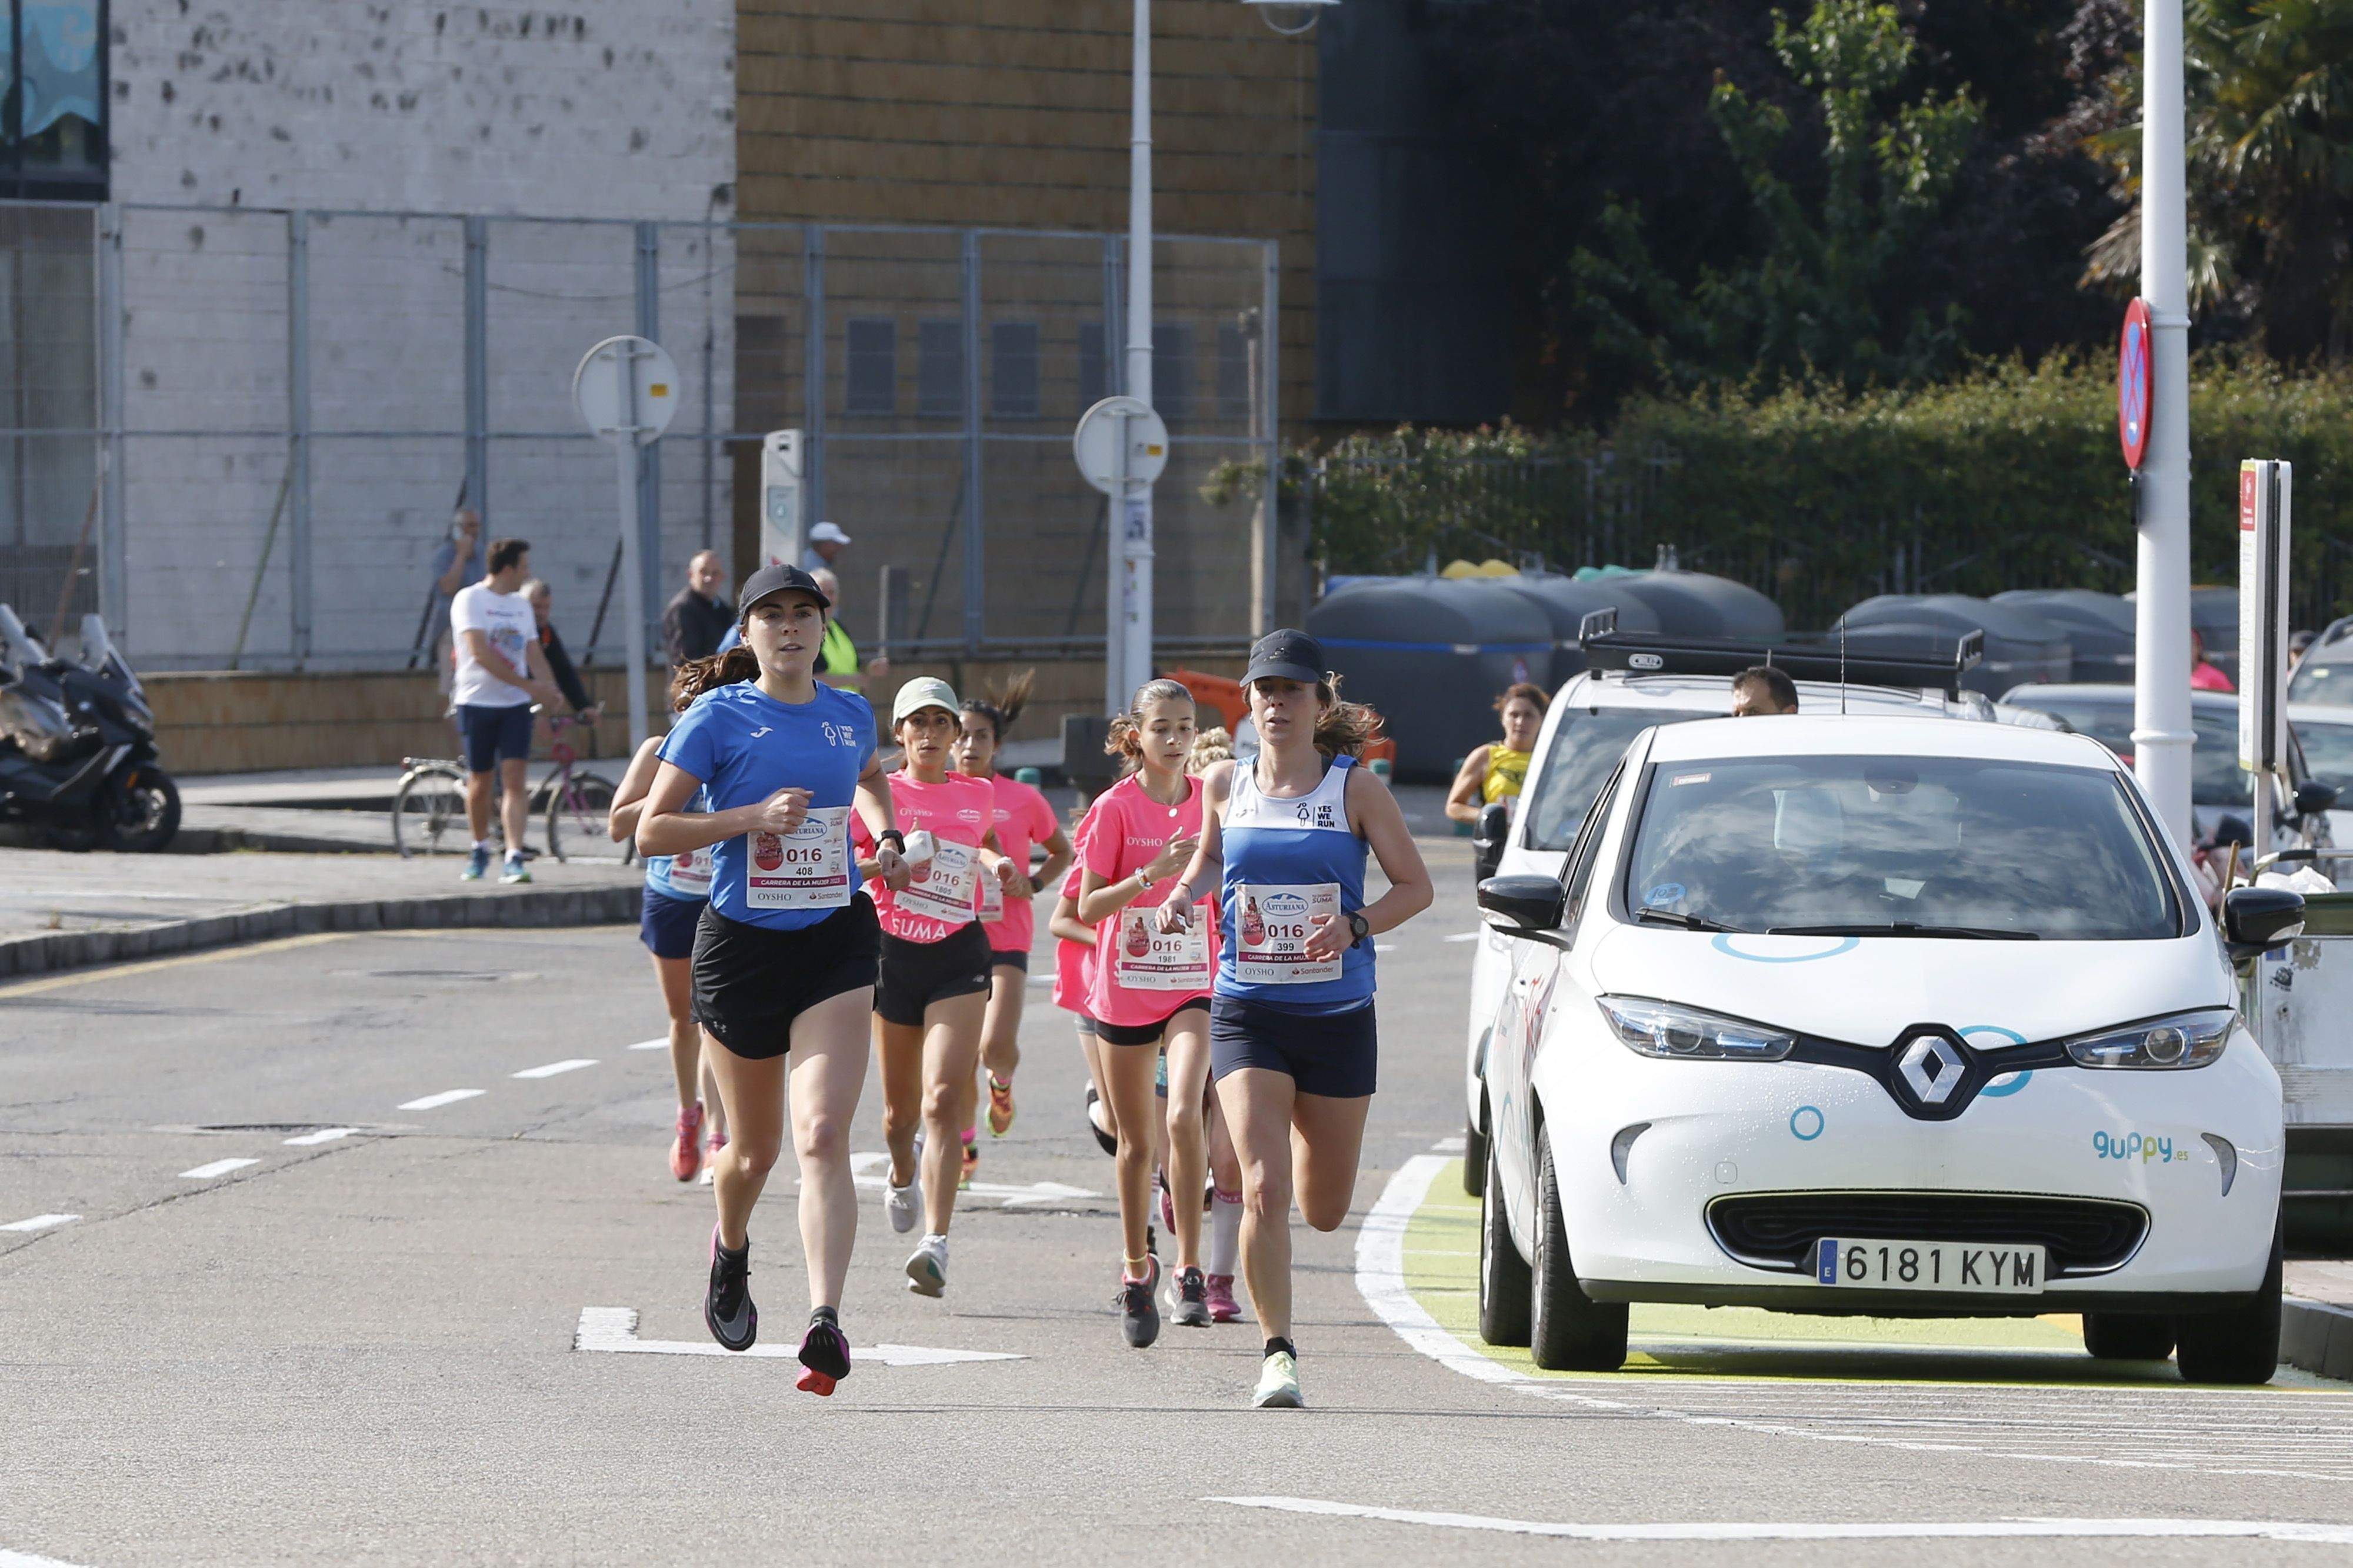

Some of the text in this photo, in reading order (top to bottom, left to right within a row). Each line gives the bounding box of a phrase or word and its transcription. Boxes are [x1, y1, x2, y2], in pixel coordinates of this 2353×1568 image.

[1126, 836, 1163, 847] OYSHO
[786, 848, 822, 862] 016
[695, 856, 709, 866] 01
[796, 867, 813, 875] 408
[933, 870, 960, 886] 016
[758, 893, 791, 901] OYSHO
[818, 892, 844, 900] Santander
[892, 918, 947, 940] SUMA
[1268, 925, 1304, 938] 016
[1152, 940, 1182, 952] 016
[1277, 943, 1294, 951] 399
[1245, 968, 1274, 976] OYSHO
[1847, 1246, 2035, 1287] 6181 KYM
[1824, 1267, 1831, 1277] E
